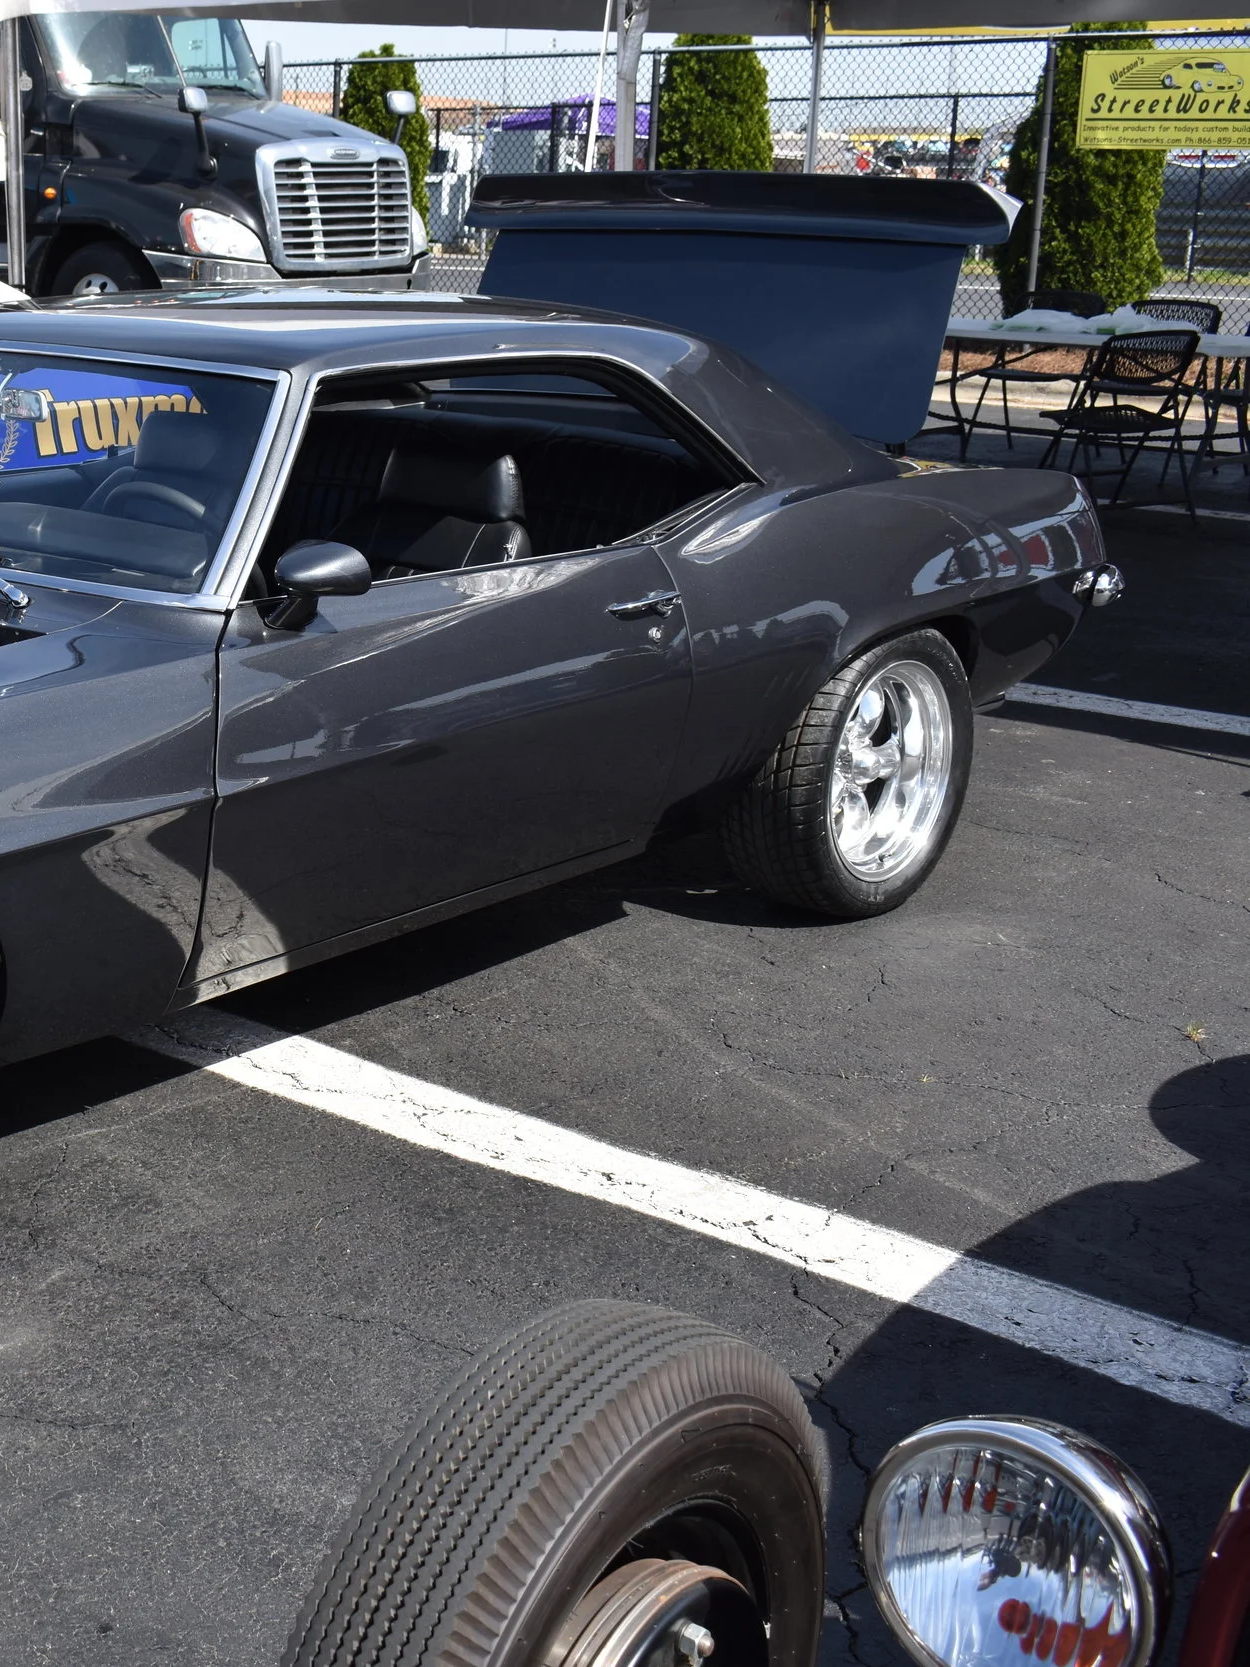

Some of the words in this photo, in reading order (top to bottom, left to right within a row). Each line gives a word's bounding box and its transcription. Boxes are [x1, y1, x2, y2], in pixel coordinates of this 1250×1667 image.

[1109, 56, 1145, 84] Watson's
[1090, 92, 1250, 114] StreetWorks
[1082, 124, 1120, 132] Innovative
[1123, 124, 1155, 133] products
[1159, 124, 1170, 132] for
[1174, 125, 1199, 134] todays
